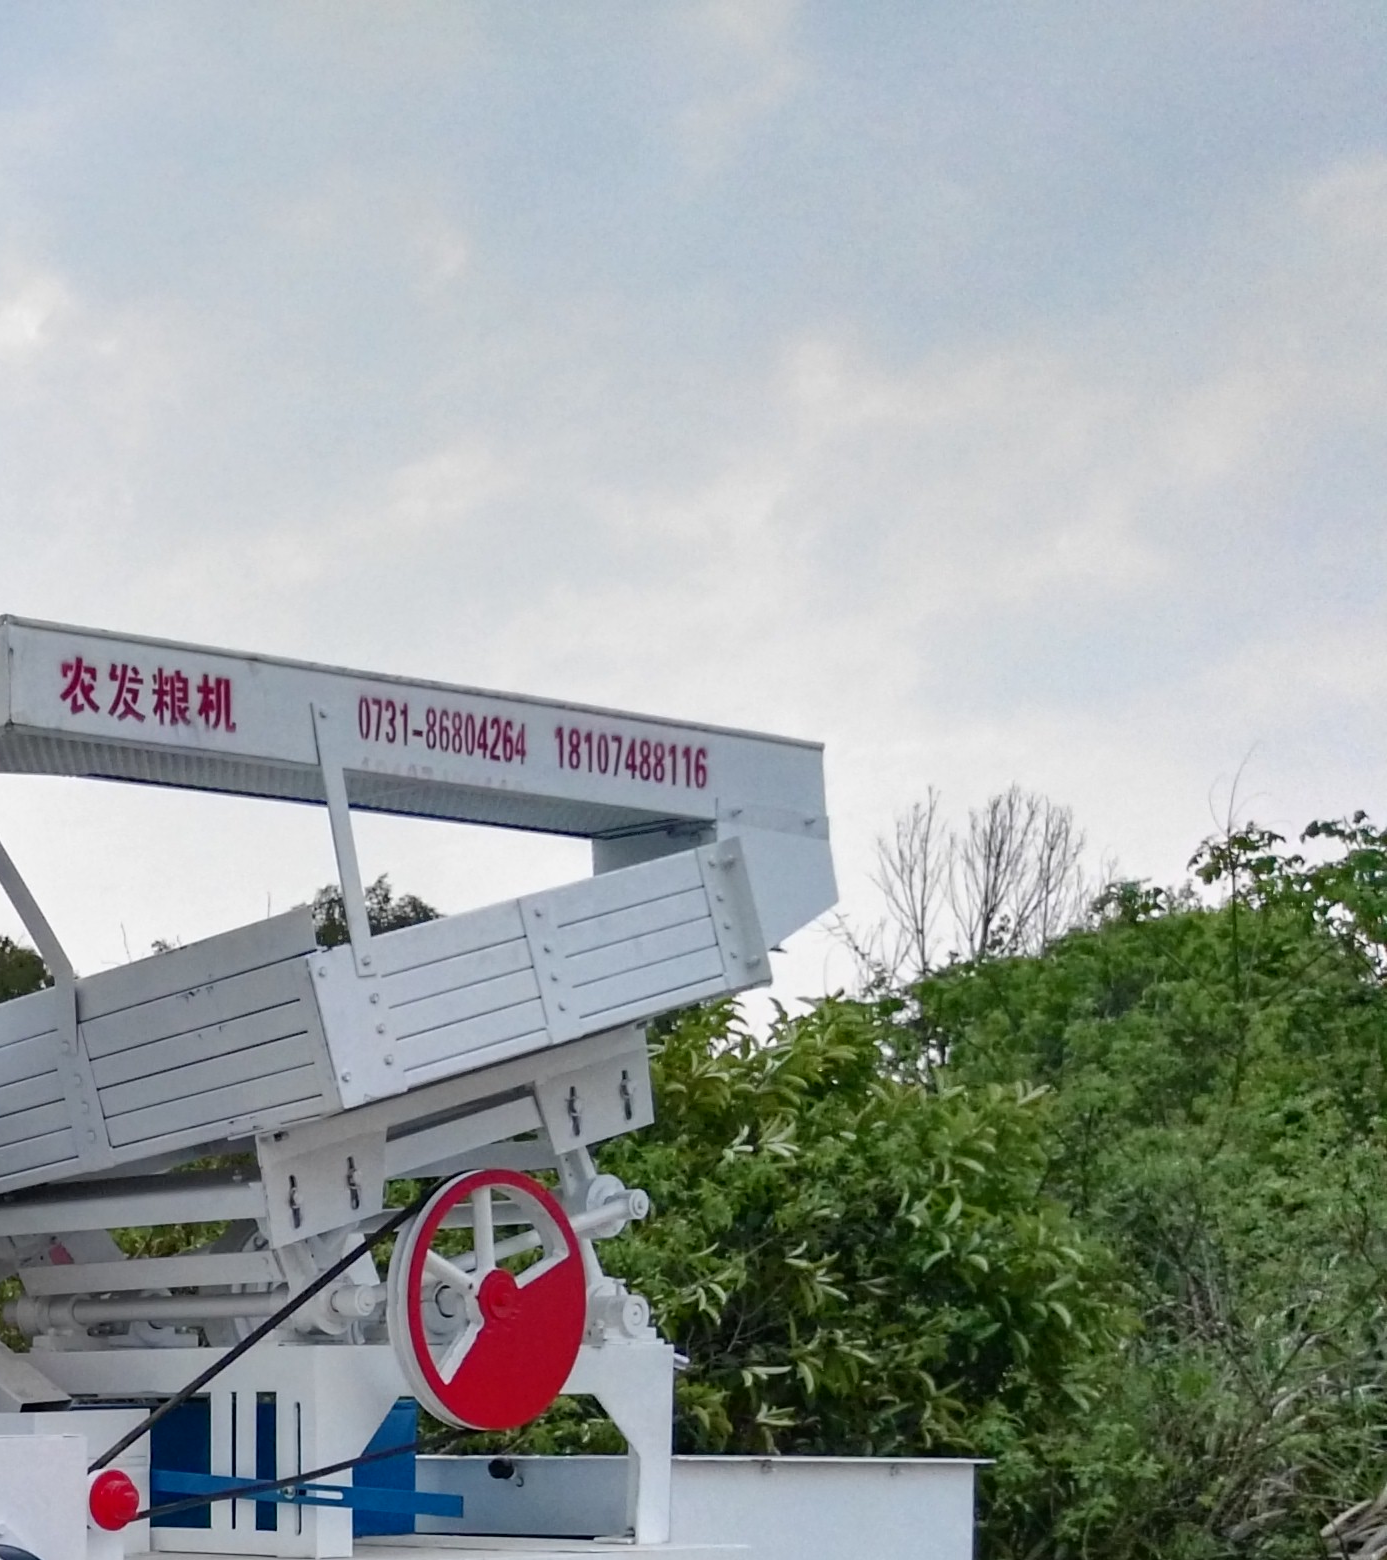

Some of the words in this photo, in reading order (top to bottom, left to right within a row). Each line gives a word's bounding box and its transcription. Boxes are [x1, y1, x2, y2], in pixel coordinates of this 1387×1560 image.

[60, 655, 236, 733] 农发粮机
[357, 696, 528, 766] 0731-86804264
[554, 726, 709, 789] 18107488116
